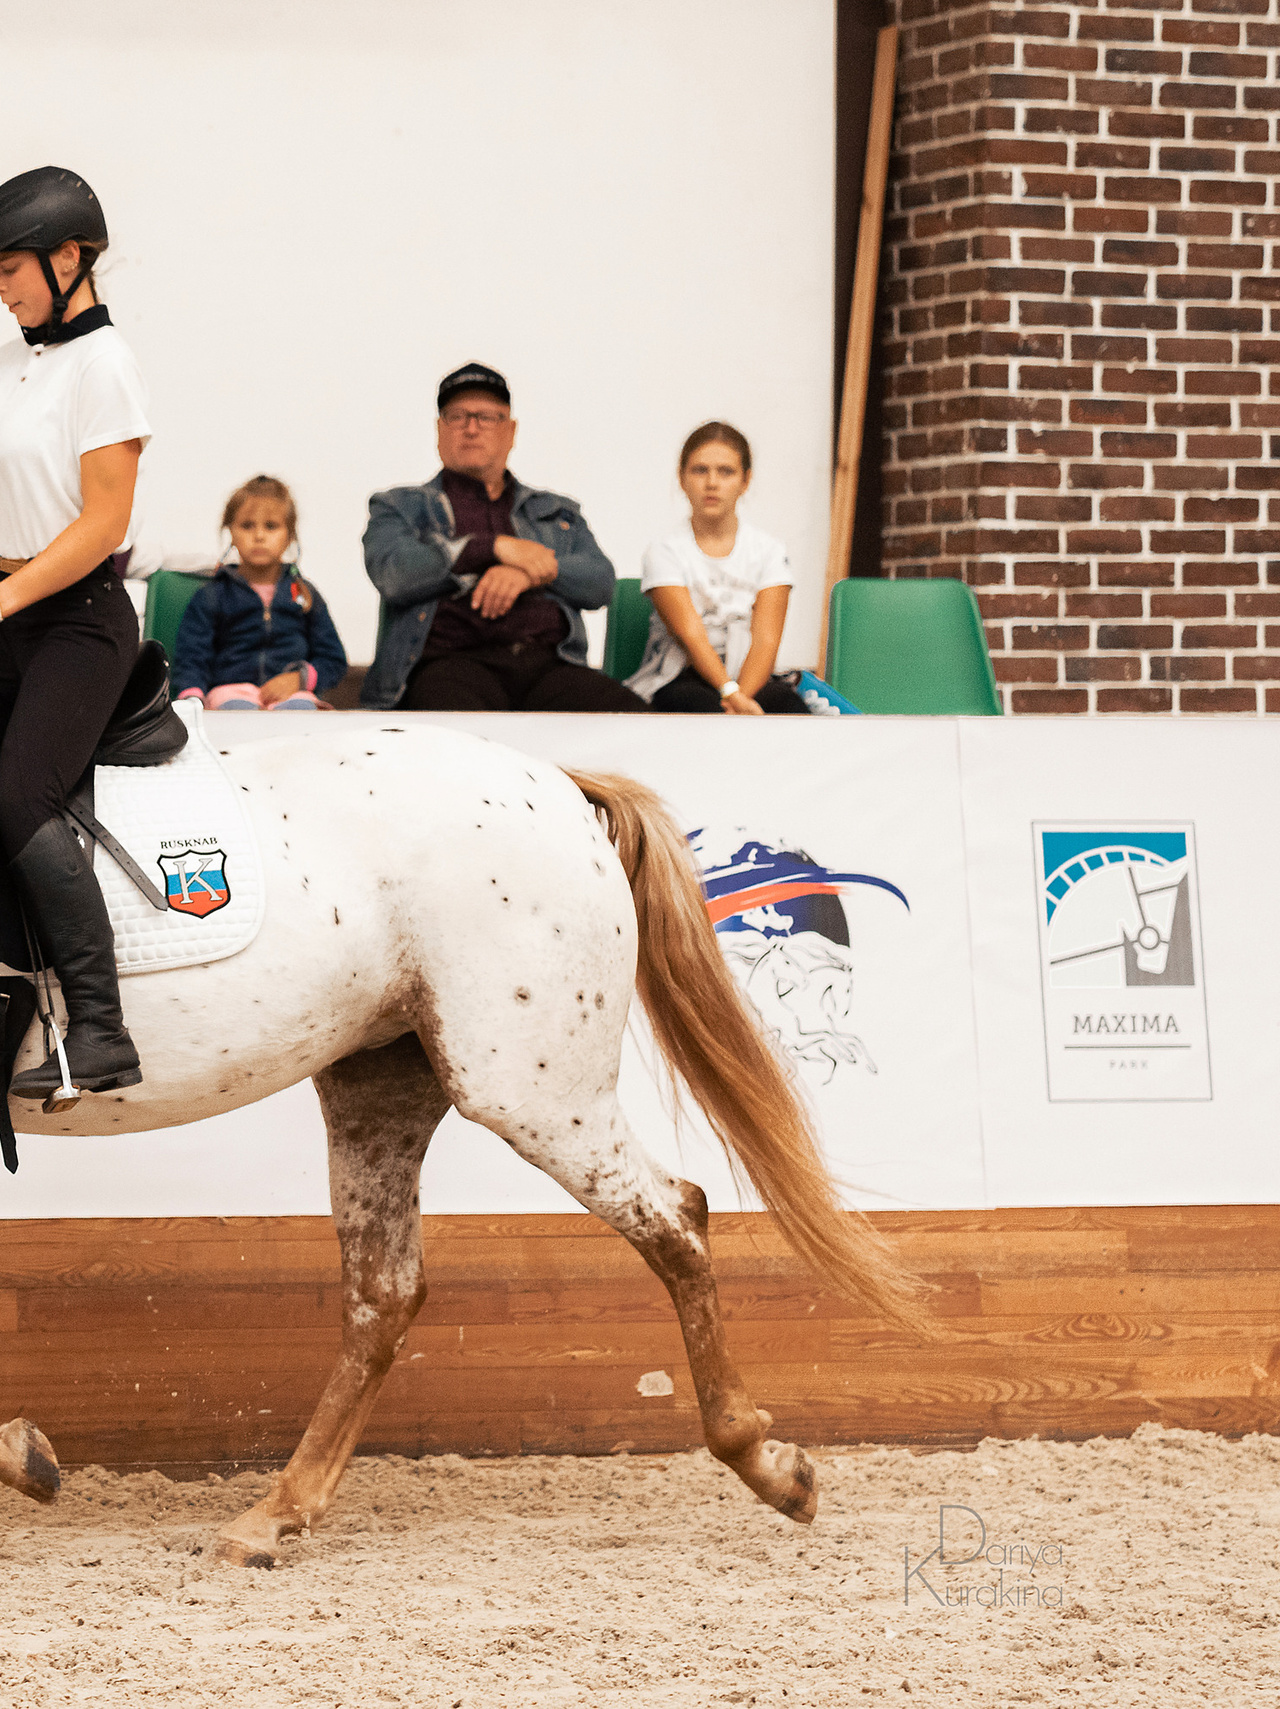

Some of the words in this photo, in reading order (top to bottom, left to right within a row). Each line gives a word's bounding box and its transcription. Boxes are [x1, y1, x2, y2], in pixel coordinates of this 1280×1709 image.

[160, 837, 218, 850] RUSKNAB
[173, 858, 224, 904] K
[1073, 1015, 1179, 1033] MAXIMA
[1109, 1060, 1148, 1069] PARK
